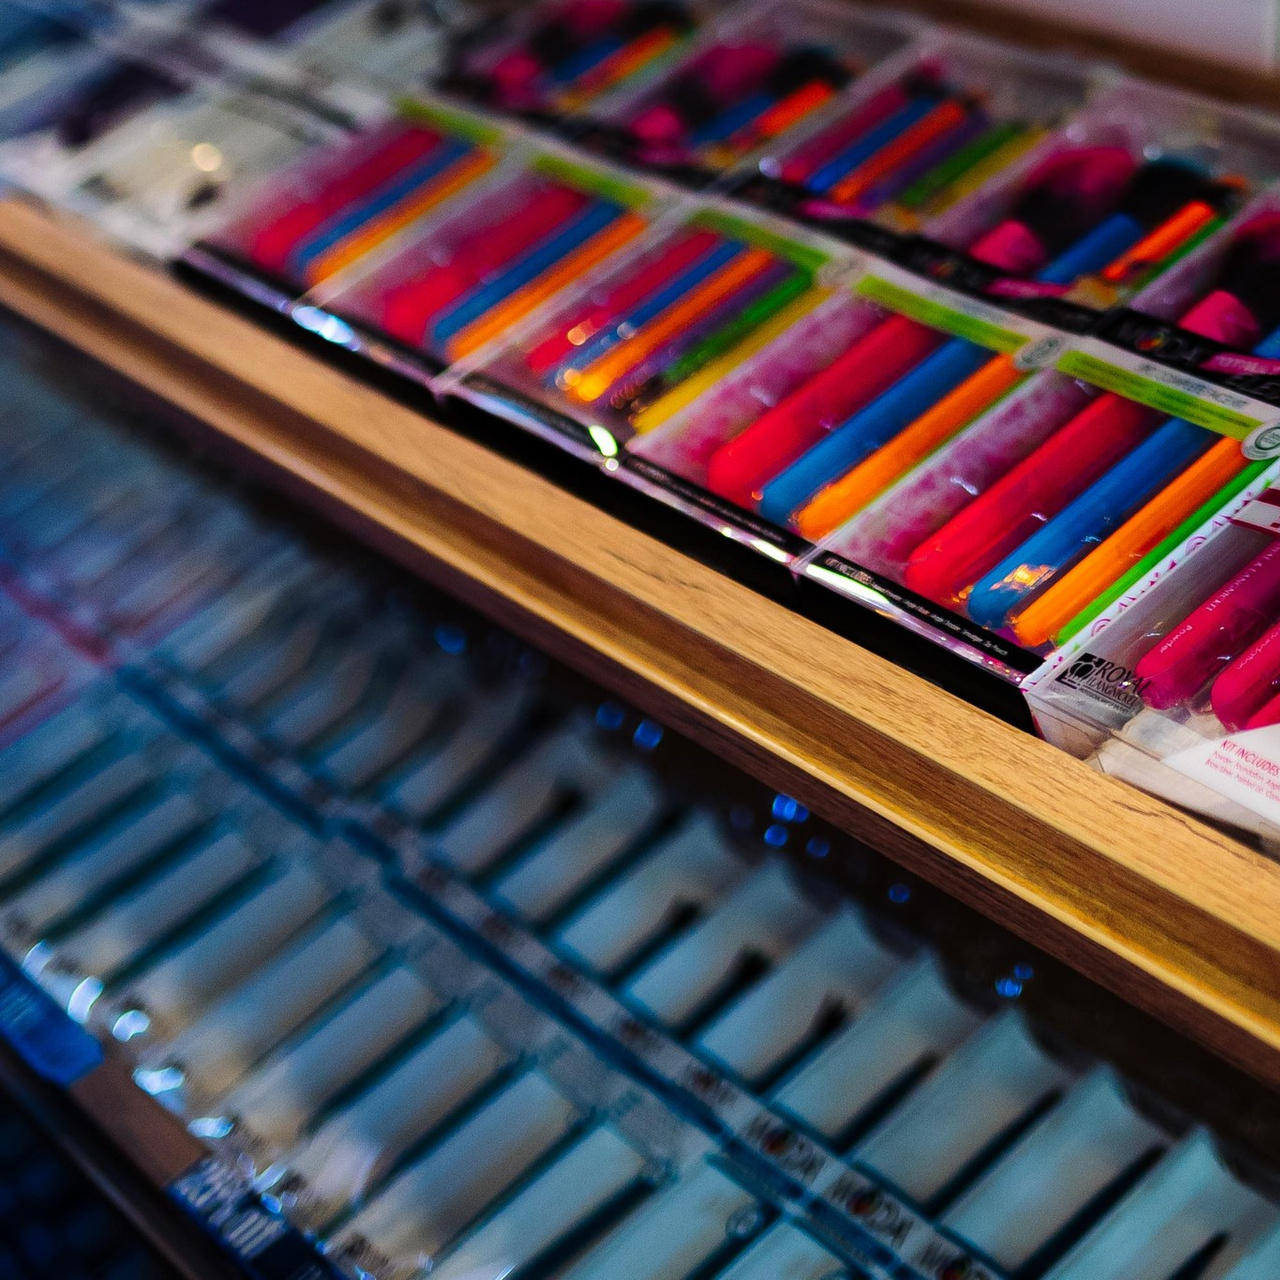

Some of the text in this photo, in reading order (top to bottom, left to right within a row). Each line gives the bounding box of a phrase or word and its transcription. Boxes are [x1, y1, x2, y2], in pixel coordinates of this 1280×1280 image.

[1158, 624, 1194, 654] Powder
[1095, 661, 1152, 696] ROYAL
[1220, 739, 1238, 753] KIT
